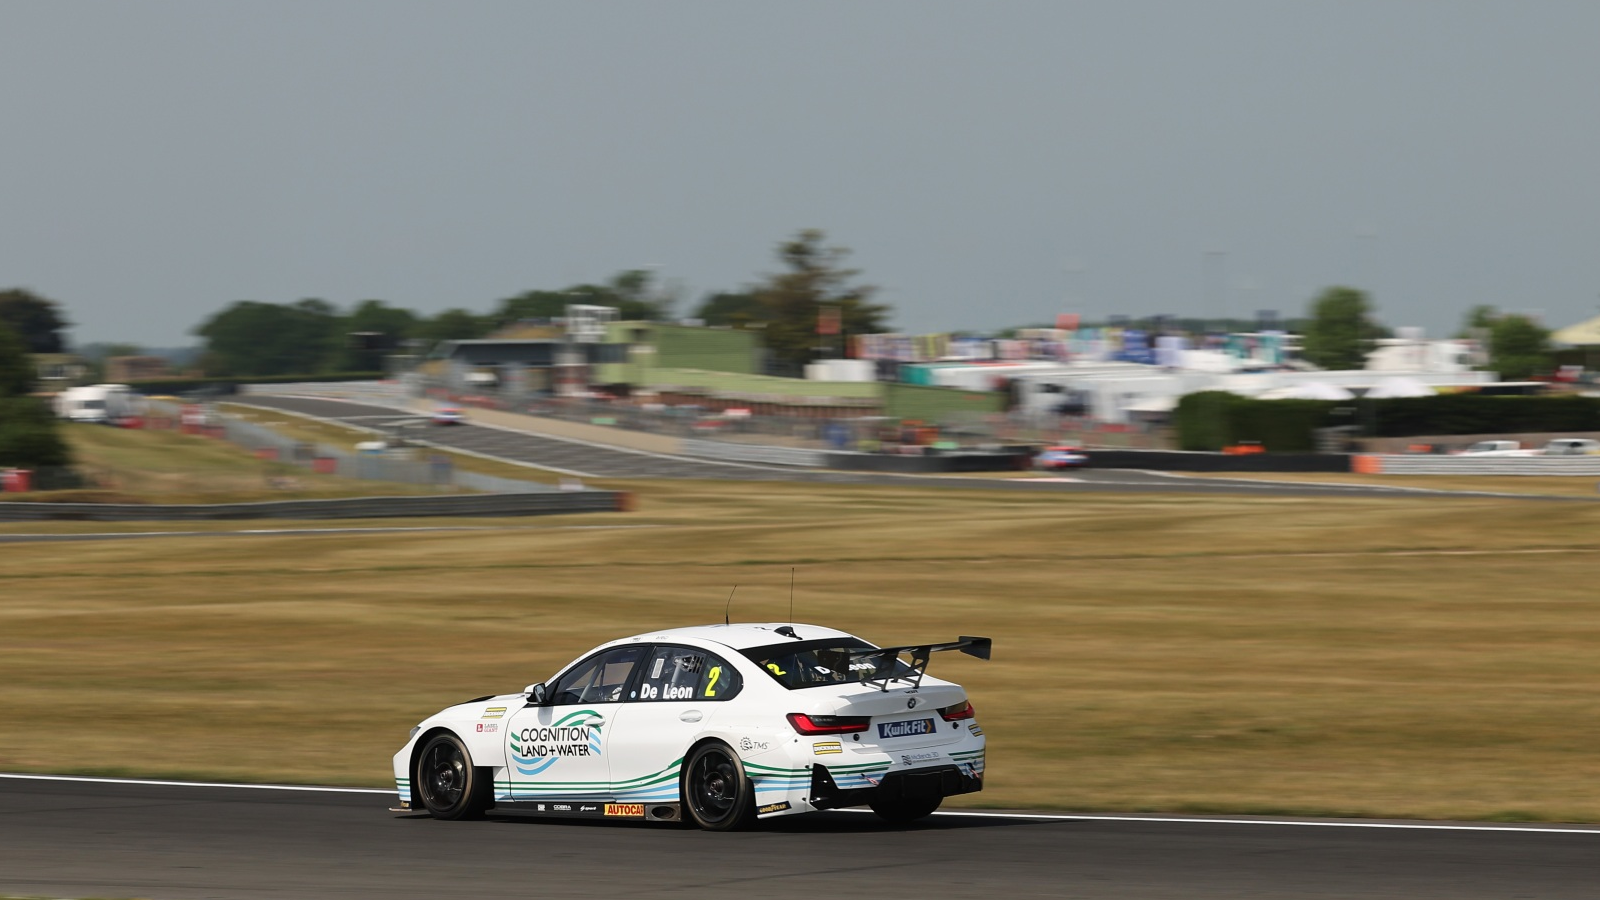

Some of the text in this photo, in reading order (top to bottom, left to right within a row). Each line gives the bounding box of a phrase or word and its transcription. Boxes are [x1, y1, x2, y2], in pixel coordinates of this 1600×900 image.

[766, 663, 787, 676] 2
[813, 662, 877, 675] D eon
[704, 666, 720, 697] 2
[640, 683, 693, 699] De Leon
[520, 727, 590, 742] COGNITION
[753, 741, 768, 750] TMS
